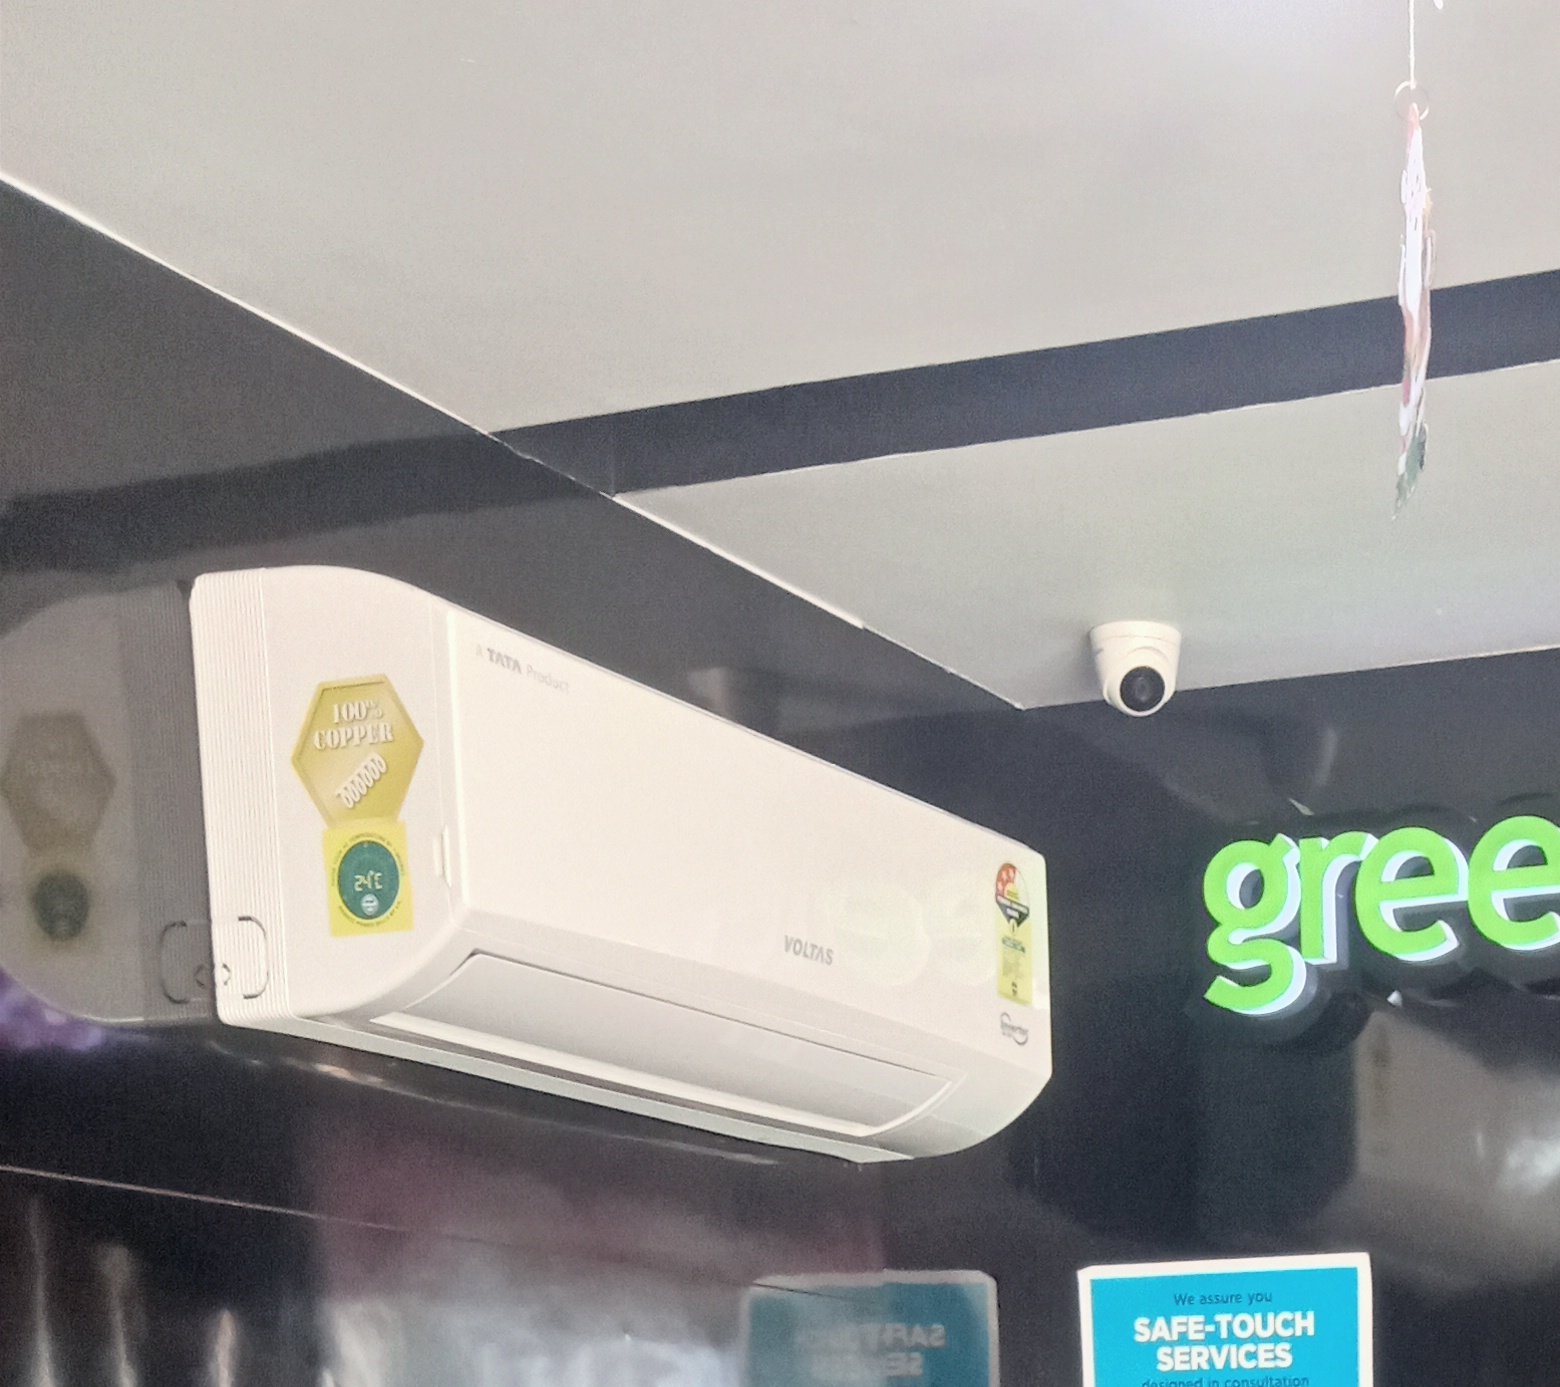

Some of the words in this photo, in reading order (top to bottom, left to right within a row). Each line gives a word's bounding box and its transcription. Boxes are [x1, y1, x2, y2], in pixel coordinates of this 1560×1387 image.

[487, 648, 521, 674] TATA
[526, 662, 570, 693] Product
[333, 700, 384, 724] 100%
[314, 723, 395, 750] COPPER
[784, 934, 834, 966] VOLTAS
[1173, 1293, 1195, 1306] We
[1200, 1293, 1242, 1305] assure
[1248, 1291, 1273, 1306] you
[1133, 1310, 1316, 1343] SAFE-TOUCH
[1156, 1342, 1294, 1373] SERVICES
